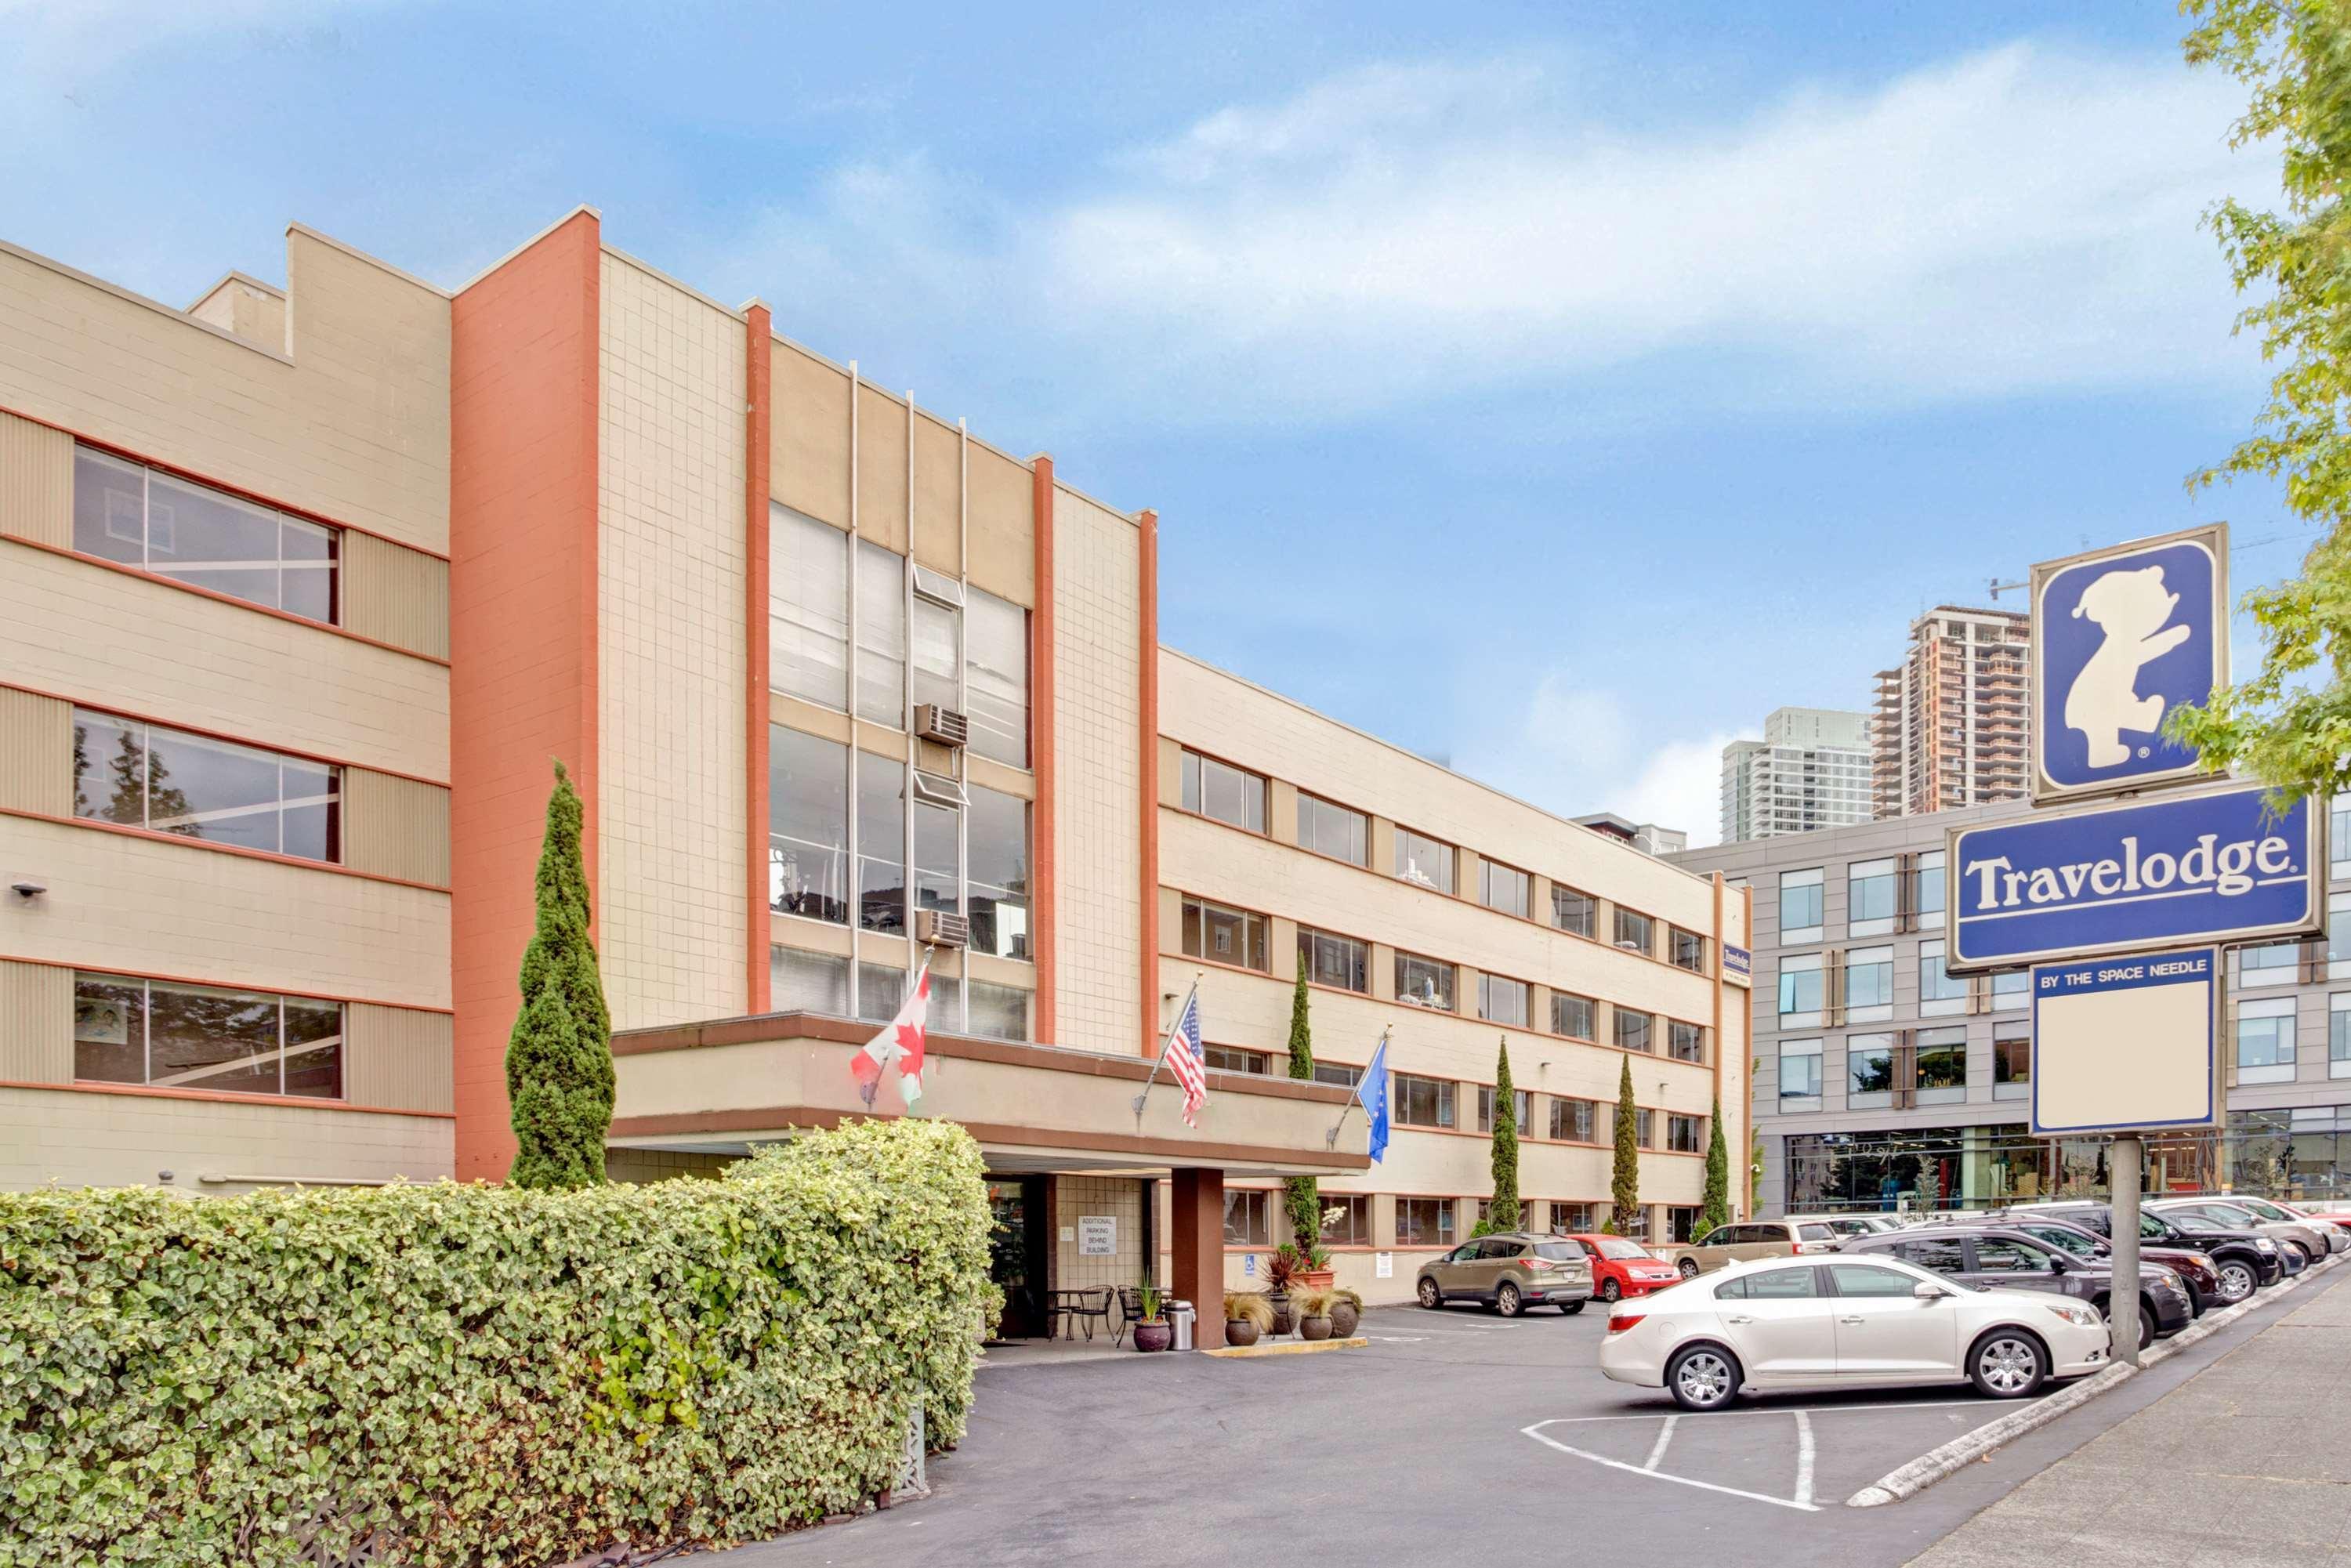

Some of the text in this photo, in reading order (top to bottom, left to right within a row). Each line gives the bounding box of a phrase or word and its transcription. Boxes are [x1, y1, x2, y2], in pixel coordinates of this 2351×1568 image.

[1965, 833, 2290, 910] Travelodge
[2041, 959, 2207, 989] BY THE SPACE NEEDLE
